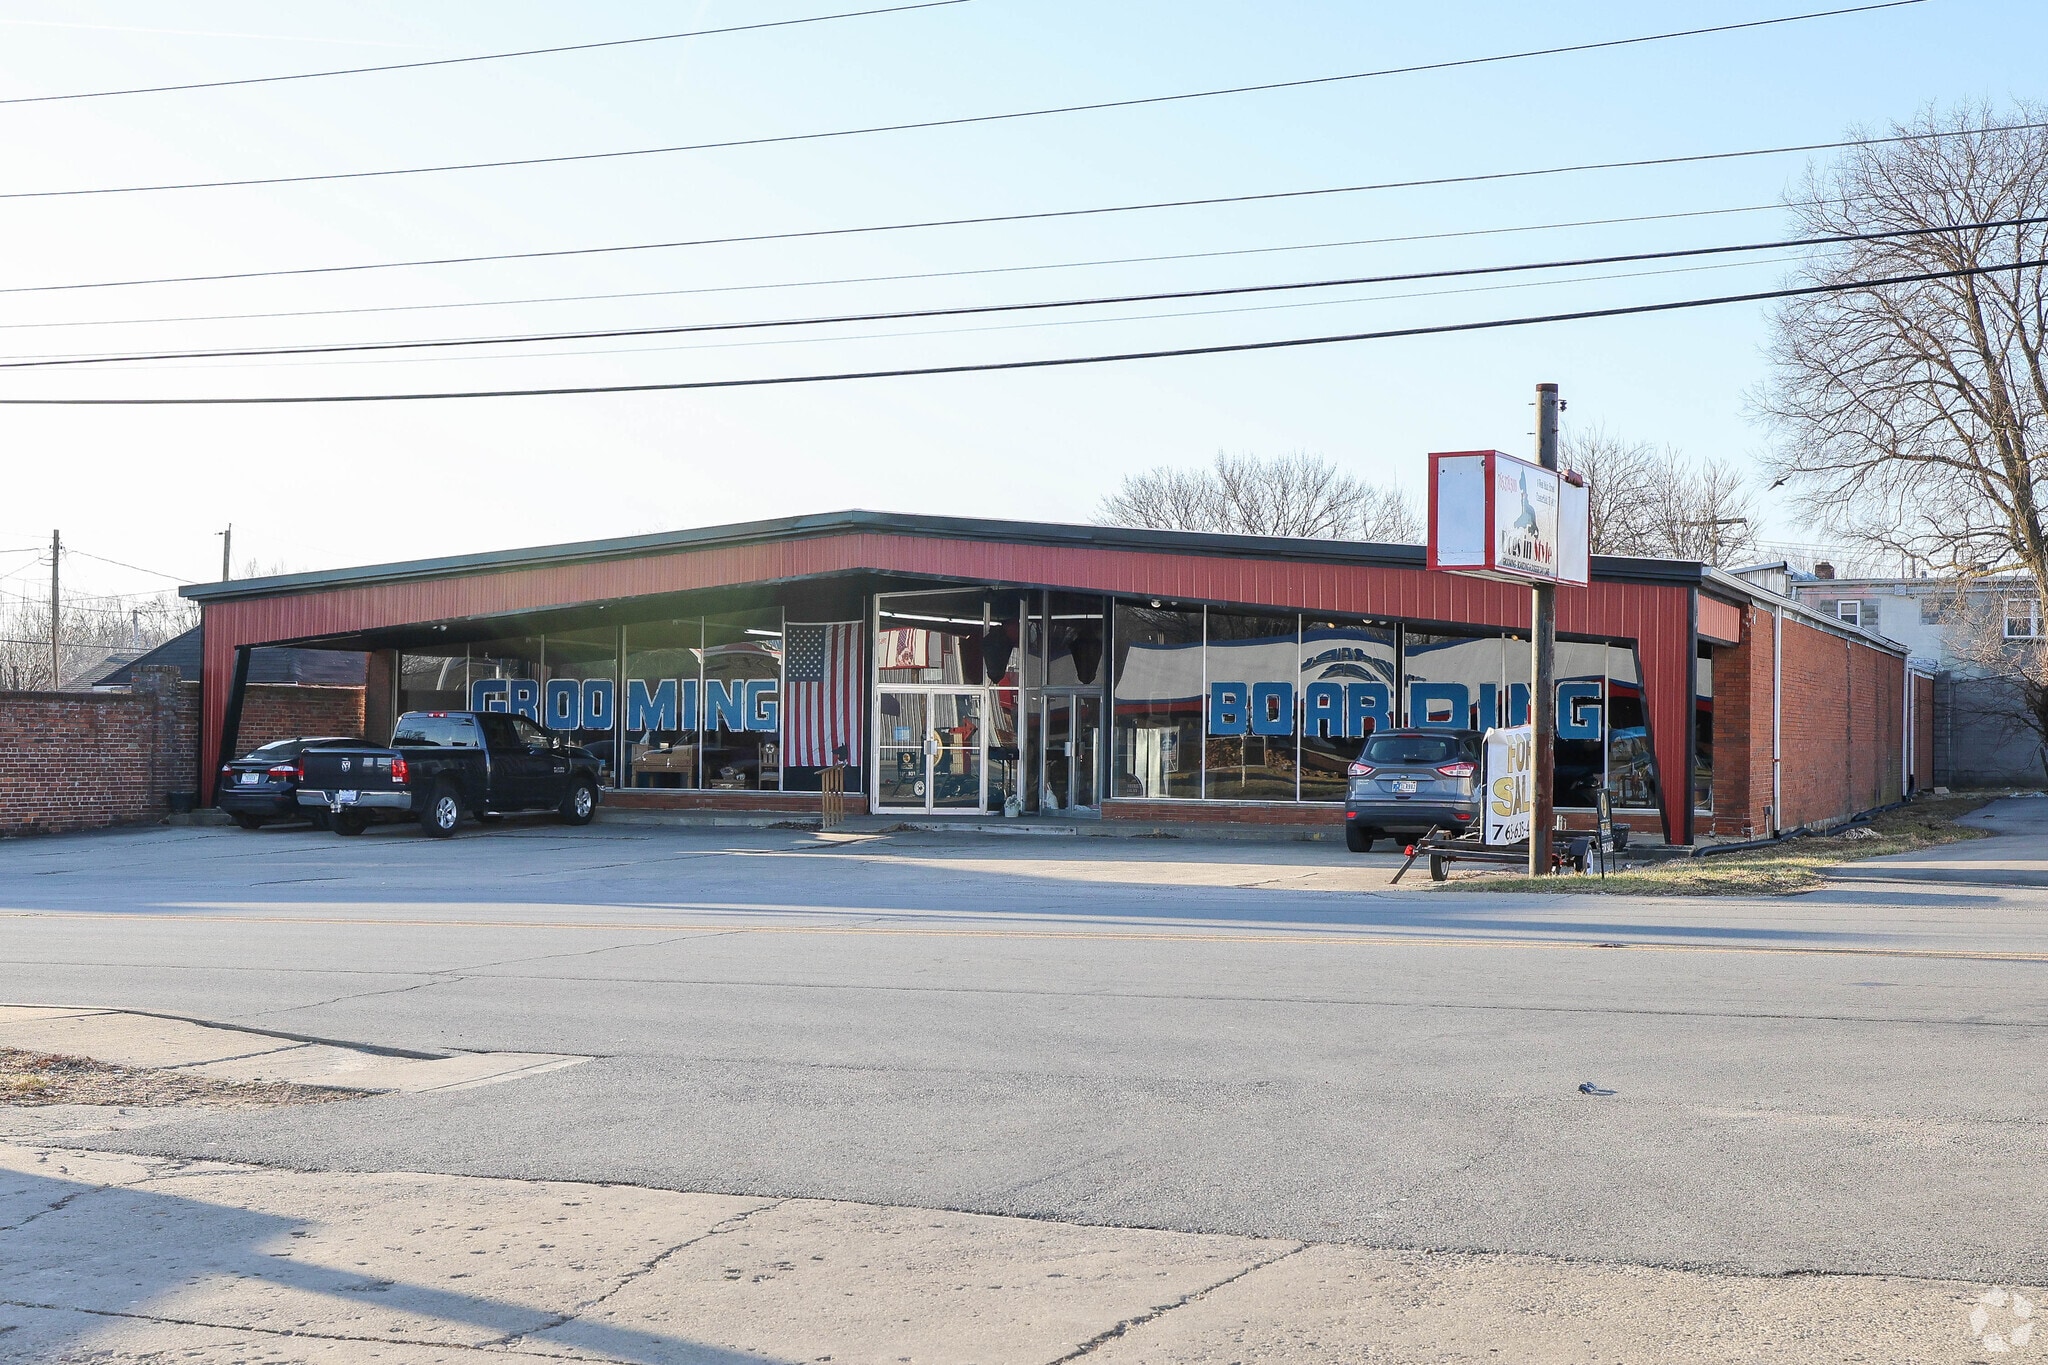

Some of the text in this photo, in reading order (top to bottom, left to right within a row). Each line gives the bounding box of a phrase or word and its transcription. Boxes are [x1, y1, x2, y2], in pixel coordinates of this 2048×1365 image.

[1523, 534, 1532, 560] in
[1533, 539, 1552, 565] Style
[470, 678, 780, 733] GROOMING
[1491, 775, 1531, 817] SAL
